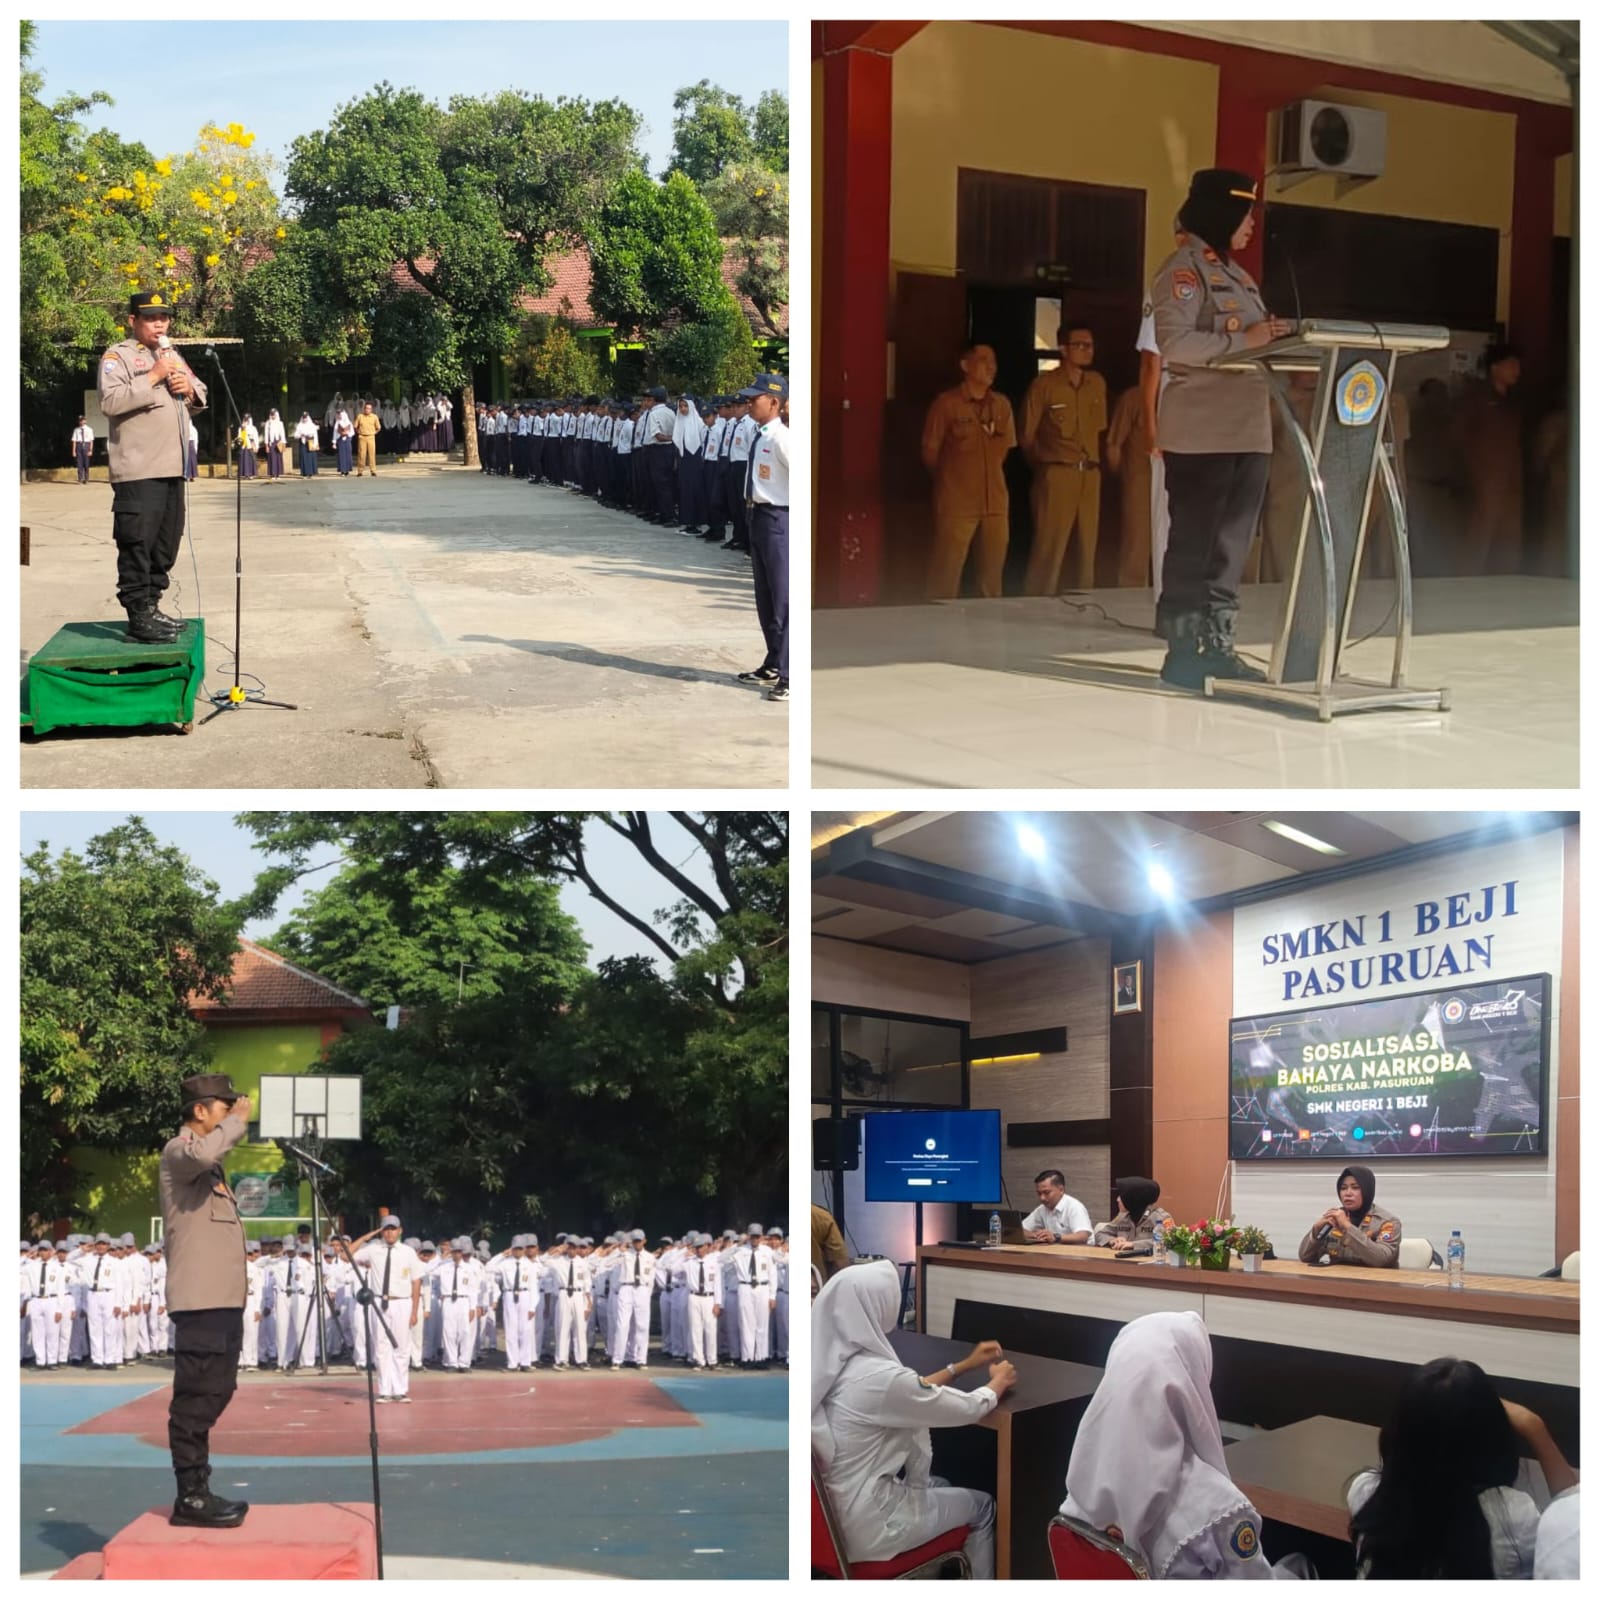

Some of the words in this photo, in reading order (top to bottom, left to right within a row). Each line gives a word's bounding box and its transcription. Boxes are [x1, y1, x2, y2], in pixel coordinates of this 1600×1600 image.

[1262, 914, 1367, 966] SMKN
[1378, 910, 1393, 943] 1
[1414, 880, 1519, 936] BEJI
[1281, 934, 1495, 1001] PASURUAN
[1302, 1031, 1439, 1063] SOSIALISASI
[1277, 1063, 1355, 1086] BAHAYA
[1361, 1051, 1472, 1079] NARKOBA
[1306, 1082, 1344, 1094] POLRES
[1346, 1080, 1371, 1091] KAB.
[1373, 1076, 1435, 1089] PASURUAN
[1307, 1101, 1333, 1115] SMK
[1336, 1098, 1383, 1113] NEGERI
[1386, 1098, 1393, 1110] 1
[1395, 1095, 1429, 1109] BEJI
